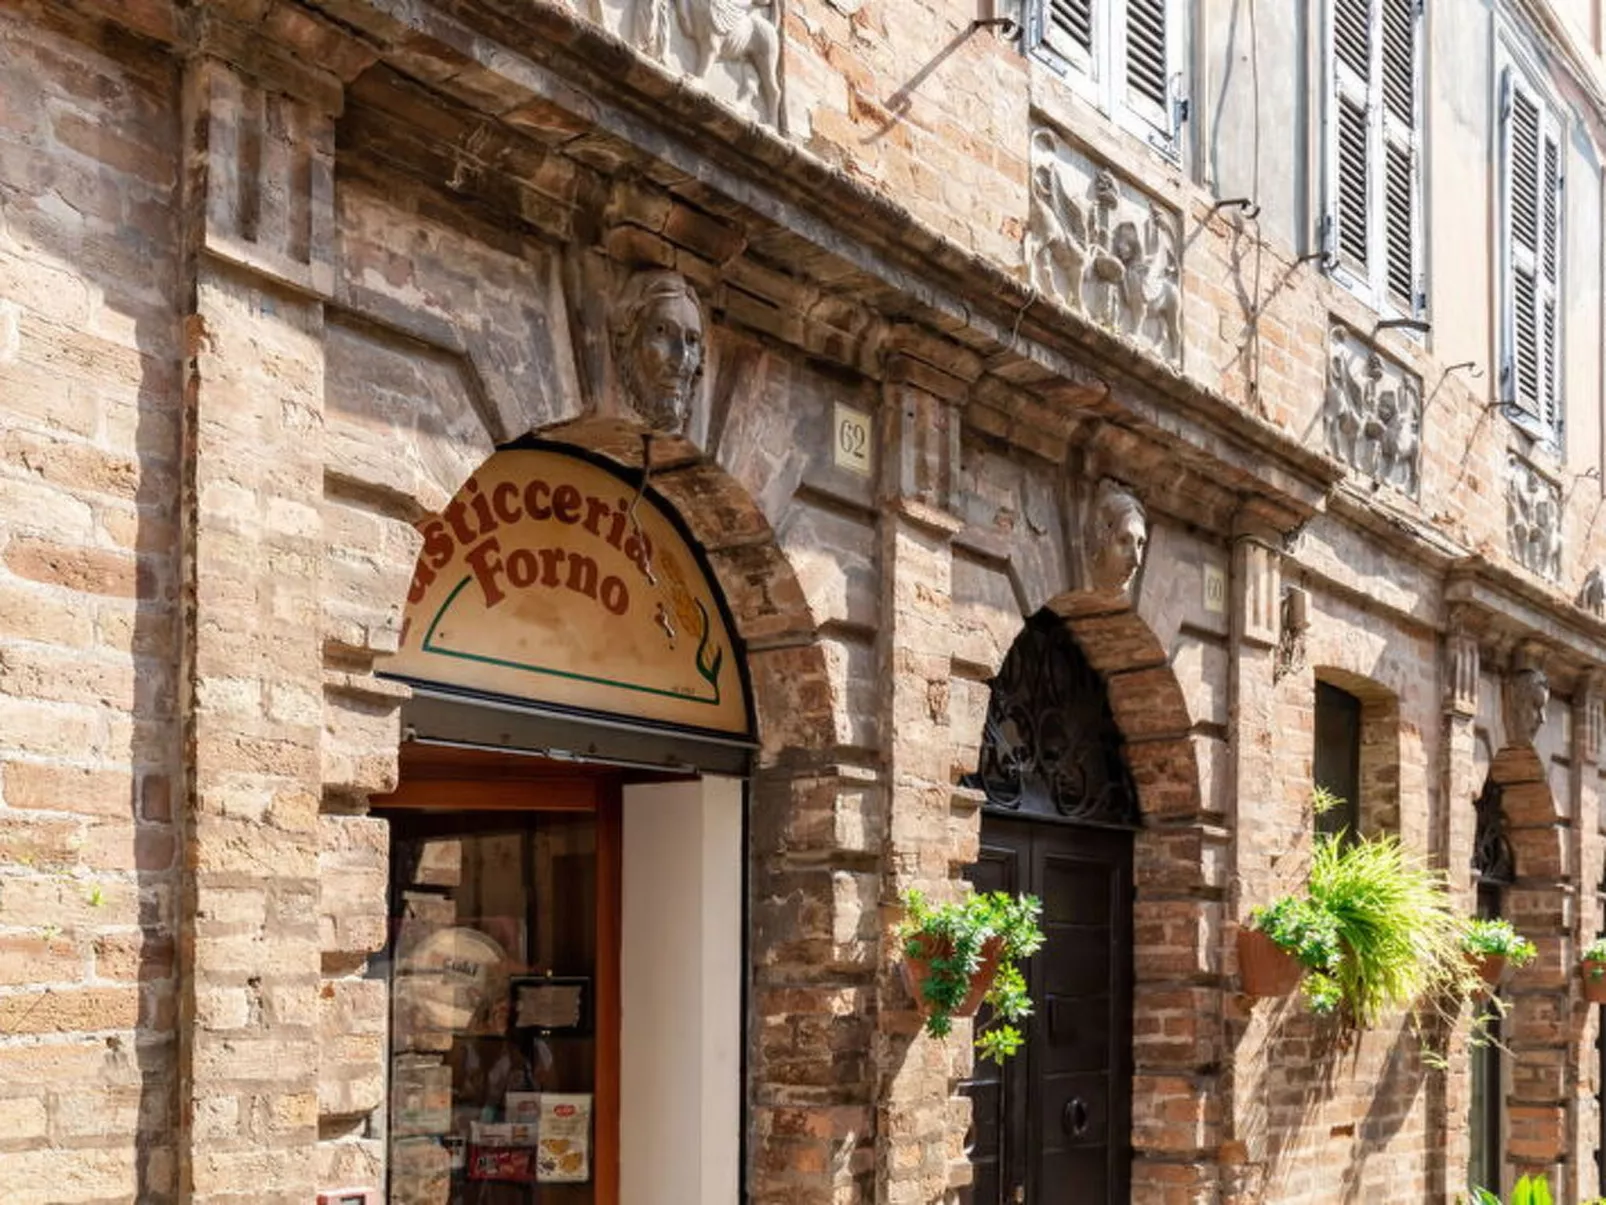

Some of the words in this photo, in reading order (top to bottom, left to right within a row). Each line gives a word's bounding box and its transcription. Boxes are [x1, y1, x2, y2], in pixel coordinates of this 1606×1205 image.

[840, 419, 865, 459] 62
[400, 476, 655, 647] asticceria
[465, 536, 630, 616] Forno
